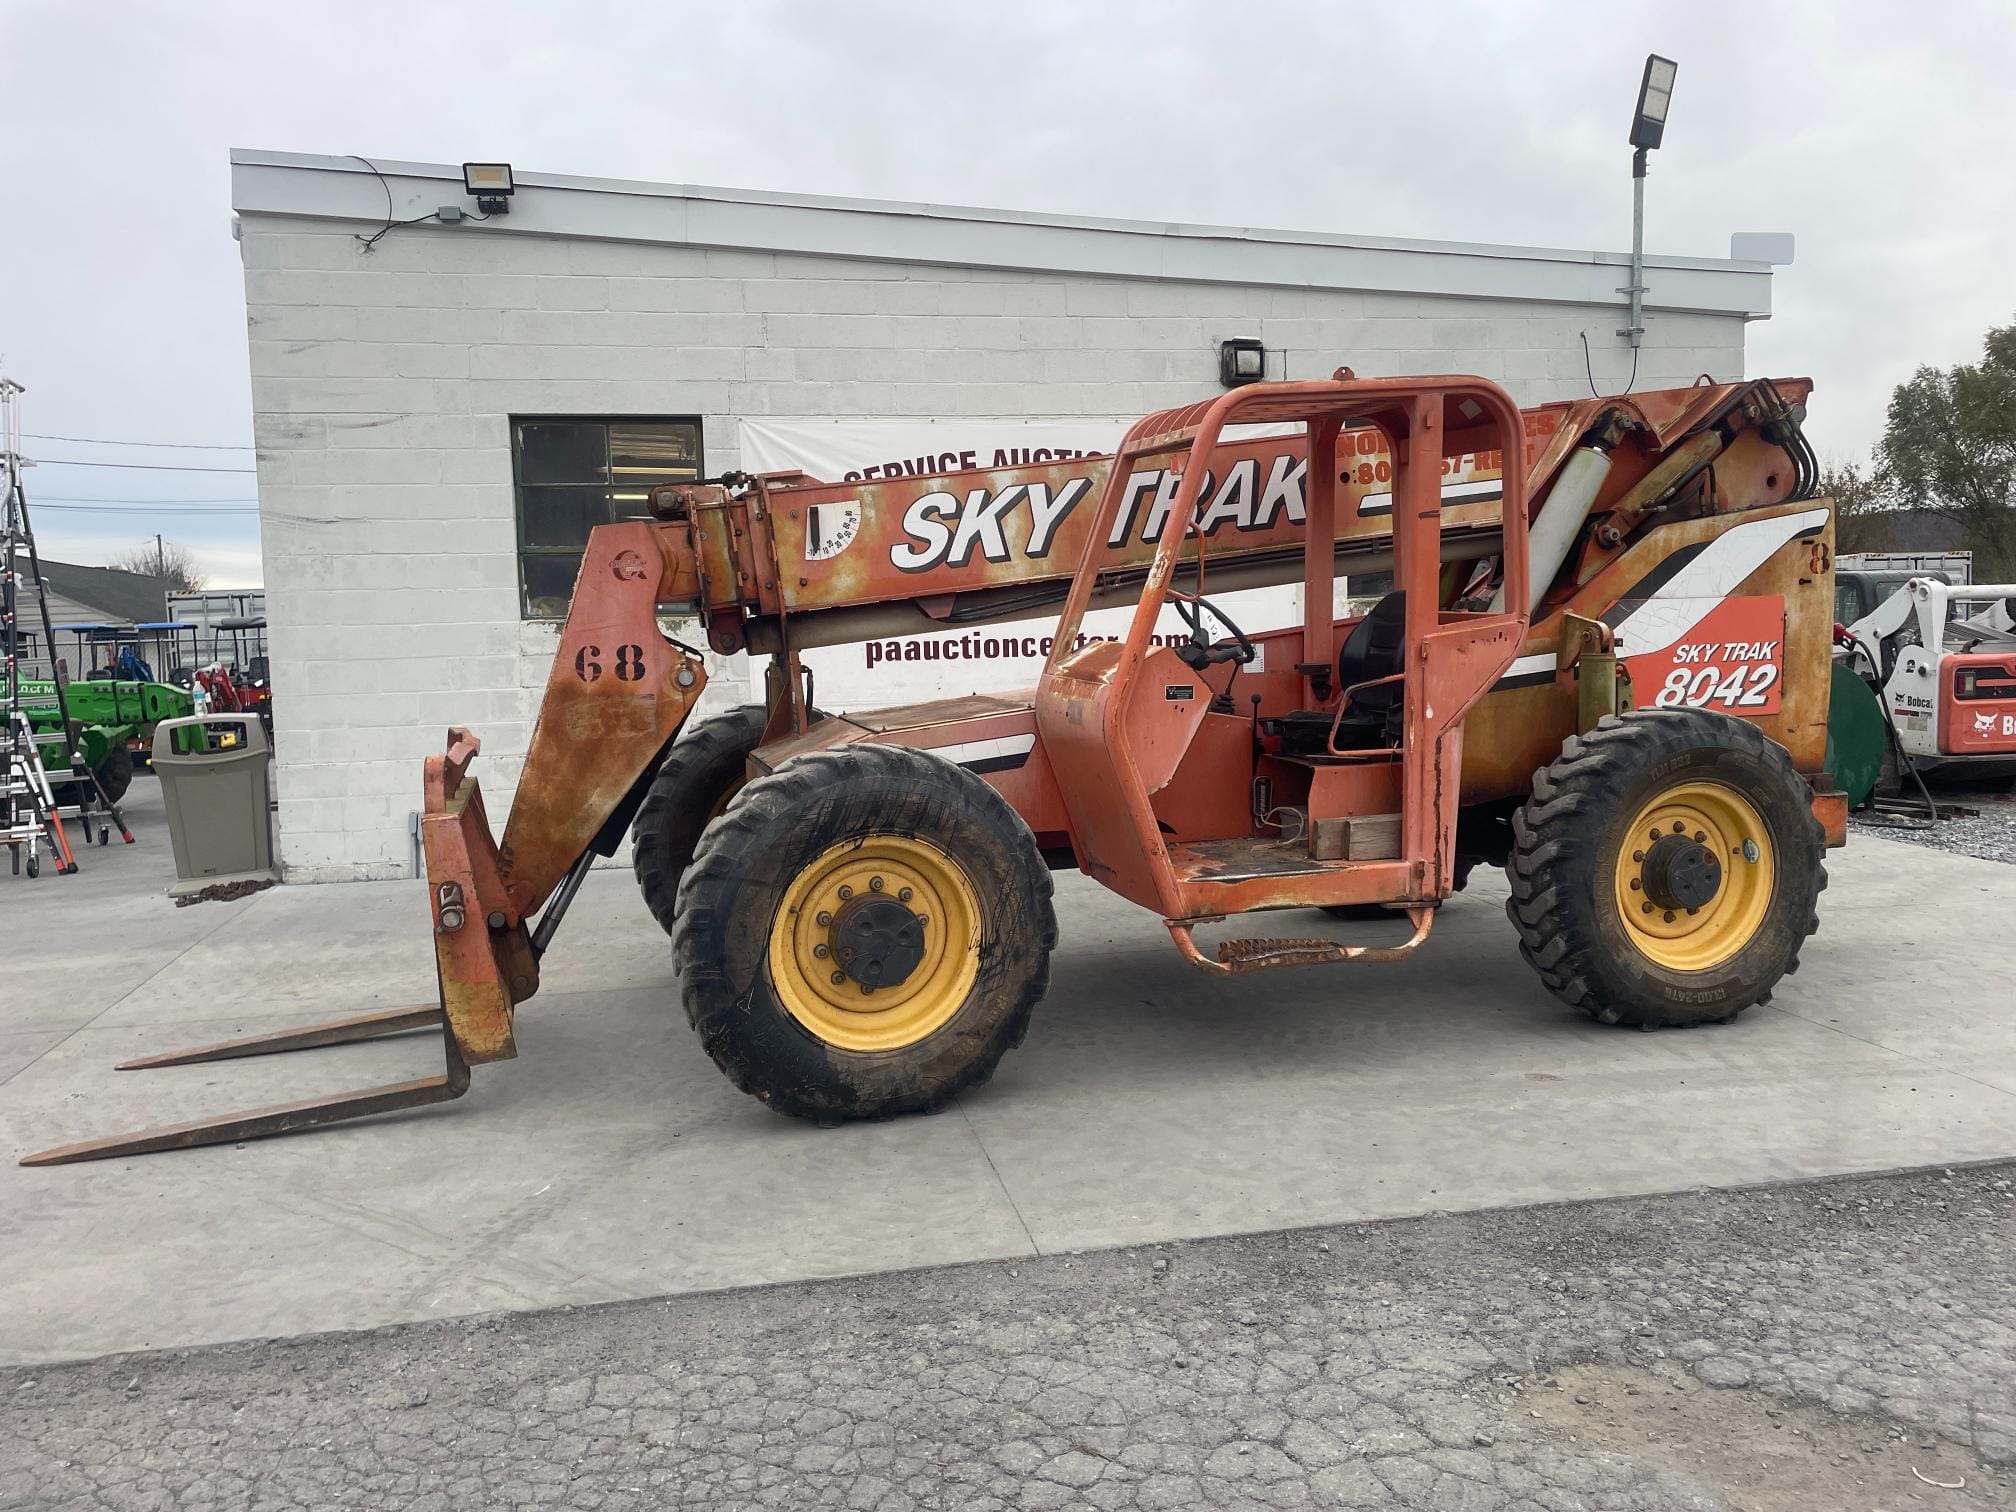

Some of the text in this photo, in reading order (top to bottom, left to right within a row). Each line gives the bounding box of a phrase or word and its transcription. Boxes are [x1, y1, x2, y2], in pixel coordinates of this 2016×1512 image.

[890, 478, 1094, 573] SKY
[575, 644, 646, 682] 68
[866, 631, 1190, 668] paauctioncetm
[1672, 641, 1779, 663] SKY TRAK
[1655, 663, 1781, 708] 8042
